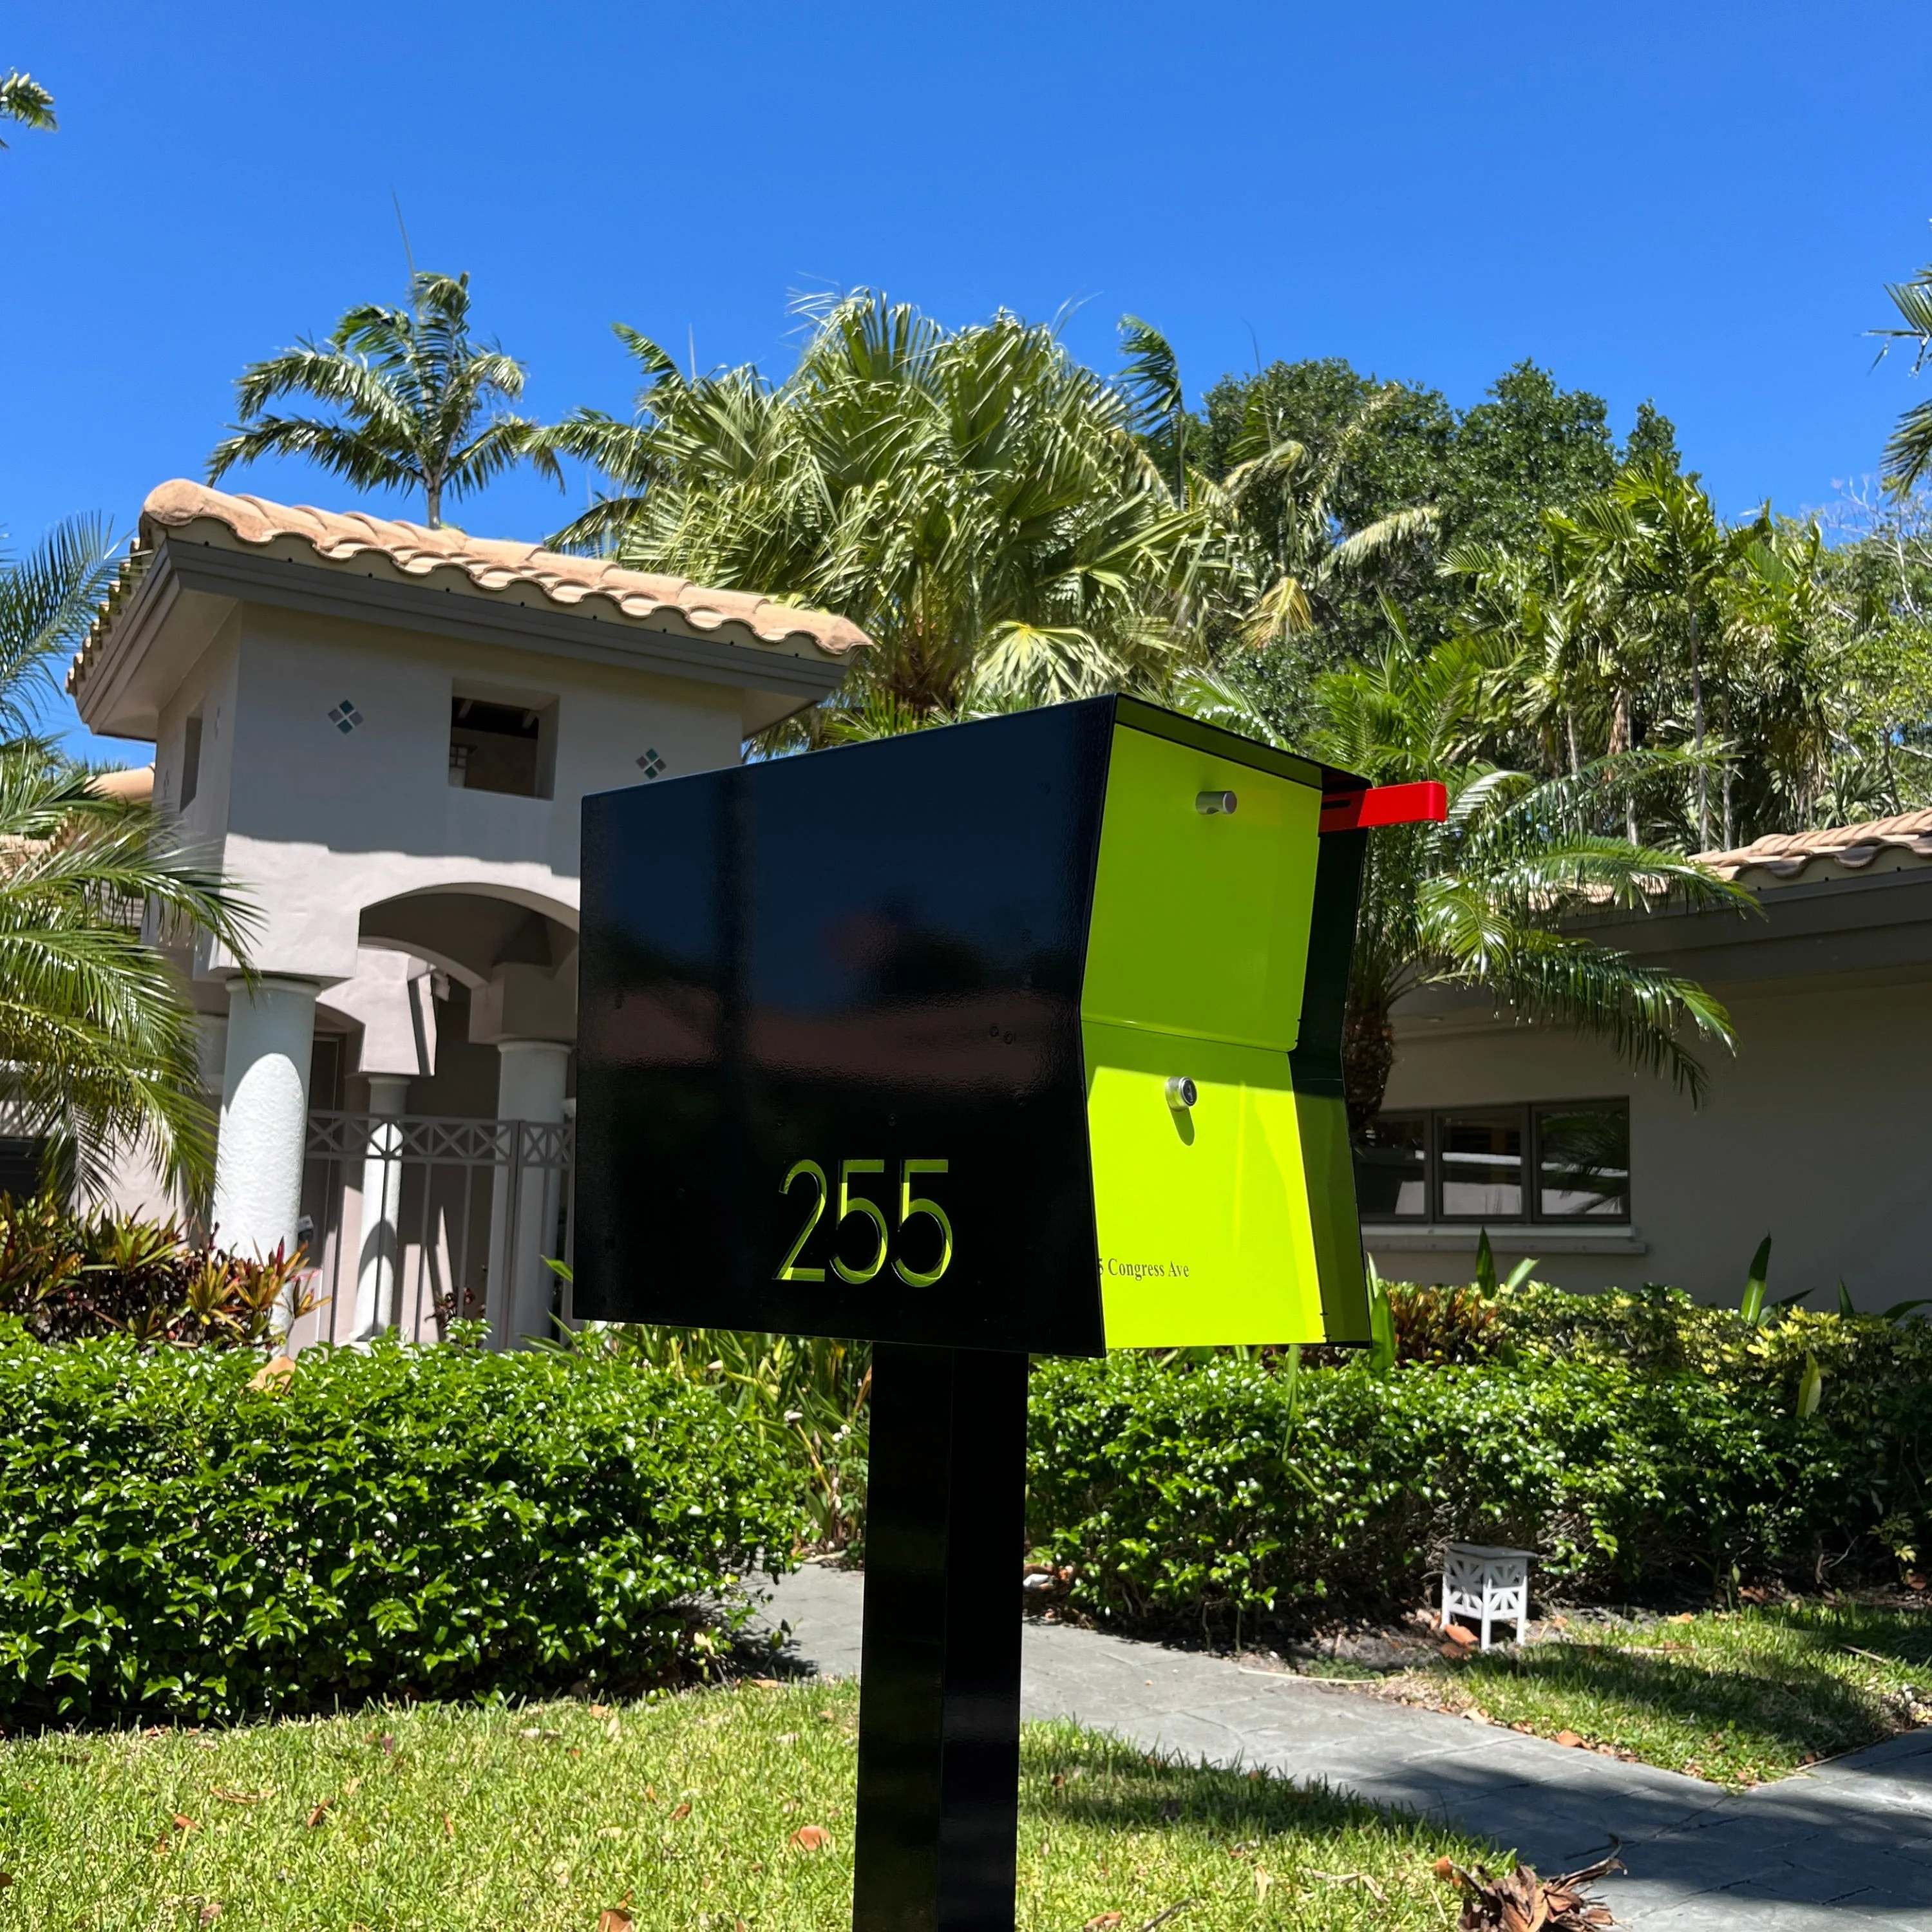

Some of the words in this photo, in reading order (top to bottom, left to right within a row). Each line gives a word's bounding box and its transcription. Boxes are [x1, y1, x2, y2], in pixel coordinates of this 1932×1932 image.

[773, 1159, 952, 1287] 255
[1108, 1258, 1164, 1281] Congress
[1168, 1261, 1189, 1277] Ave
